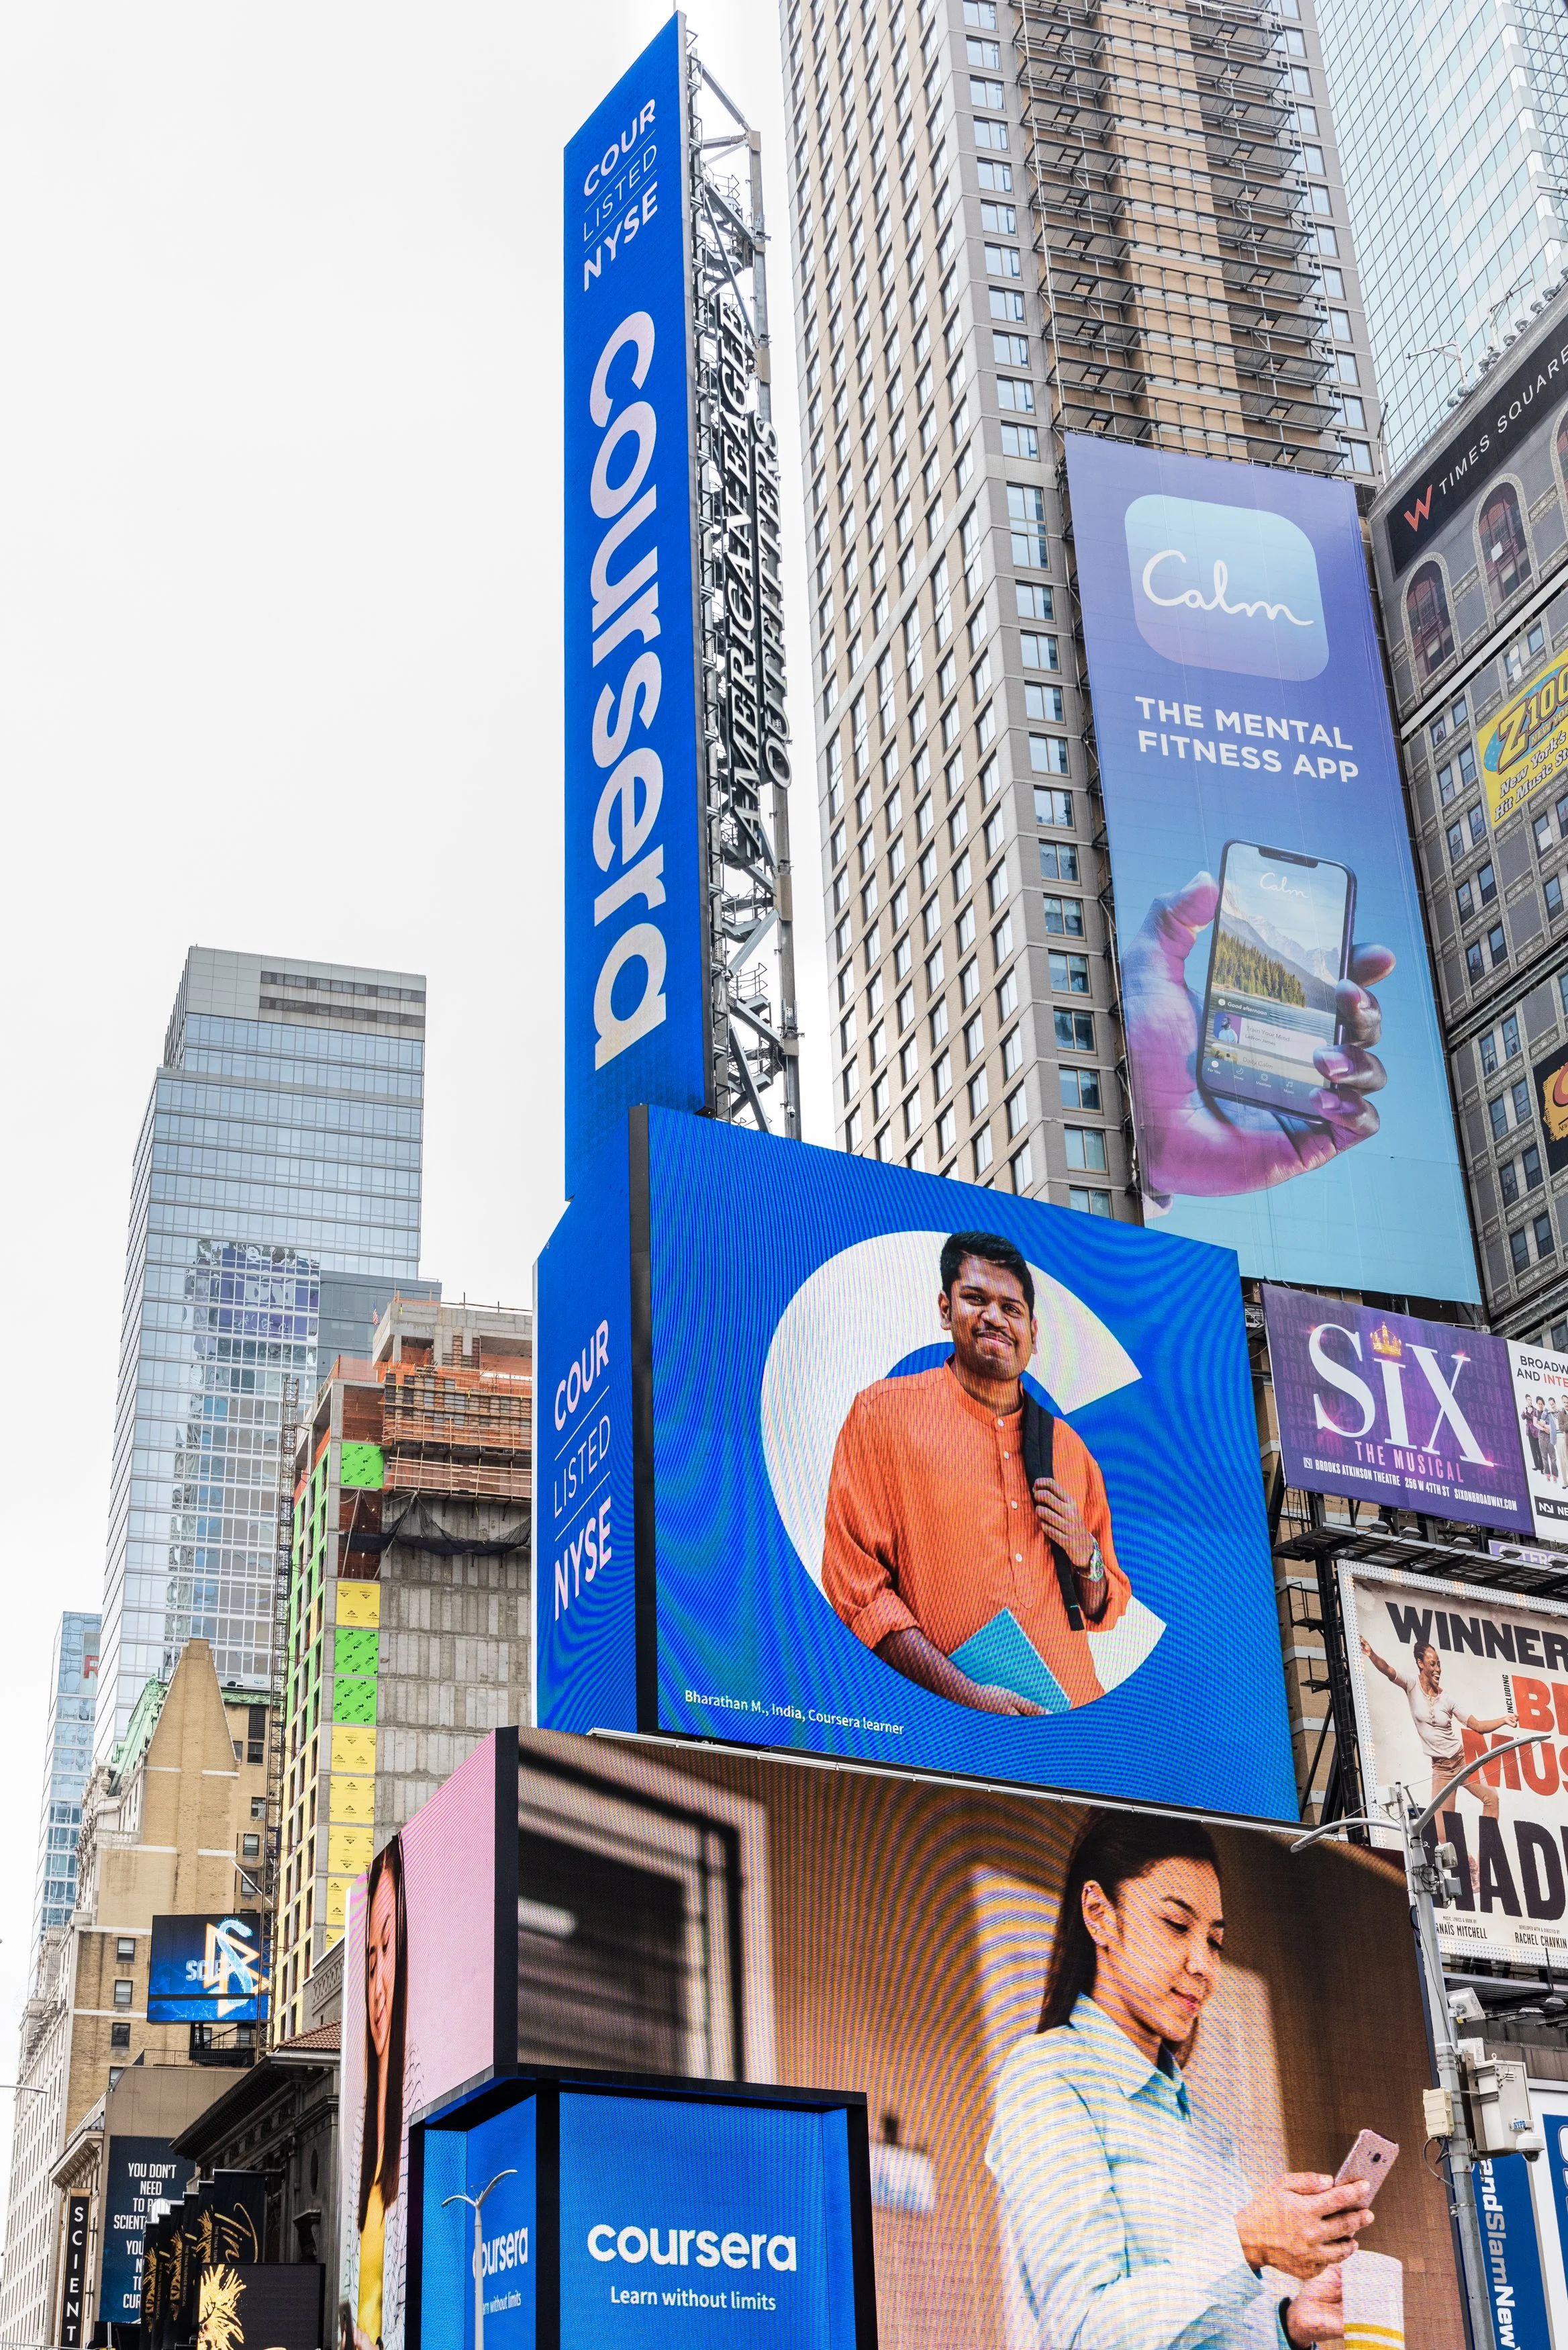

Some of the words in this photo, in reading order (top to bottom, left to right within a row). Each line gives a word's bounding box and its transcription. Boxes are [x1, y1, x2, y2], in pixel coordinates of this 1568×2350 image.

[584, 99, 656, 196] COUR
[583, 145, 657, 242] LISTED
[584, 181, 658, 291] NYSE
[718, 293, 750, 496] EAGLE
[1404, 484, 1432, 532] W
[1439, 434, 1489, 496] TIMES
[1497, 344, 1568, 434] SQUARE
[750, 411, 793, 790] OUTFITTERS
[1142, 550, 1314, 626] Calm
[590, 311, 667, 1071] coursera
[724, 473, 762, 855] AMERICAN
[1135, 696, 1204, 728] THE
[1215, 708, 1354, 751] MENTAL
[1138, 730, 1282, 773] FITNESS
[1293, 754, 1359, 783] APP
[1500, 765, 1529, 799] New
[1530, 730, 1566, 769] York's
[1495, 798, 1513, 822] Hit
[1515, 763, 1553, 803] Music
[1259, 872, 1310, 899] Calm
[1228, 1001, 1242, 1010] Good
[1243, 1006, 1267, 1016] afternoon
[1246, 1025, 1261, 1033] Train
[1261, 1029, 1275, 1037] Your
[1275, 1033, 1290, 1041] Mind
[554, 1319, 609, 1431] COUR
[1308, 1323, 1494, 1467] SIX
[1517, 1368, 1540, 1381] AND
[554, 1415, 611, 1519] LISTED
[1315, 1460, 1340, 1474] BROOKS
[1342, 1464, 1373, 1480] ATKINSON
[1373, 1470, 1401, 1486] THEATRE
[1404, 1477, 1417, 1491] 256
[1418, 1480, 1424, 1491] W
[1426, 1482, 1441, 1495] 47TH
[1442, 1487, 1450, 1497] ST
[1454, 1488, 1518, 1511] SIXONBROADWAY.COM
[1355, 1441, 1386, 1466] THE
[1393, 1448, 1464, 1483] MUSICAL
[554, 1496, 611, 1621] NYSE
[1385, 1601, 1568, 1673] WINNER
[685, 1689, 748, 1711] Bharathan
[751, 1699, 769, 1717] M.,
[772, 1703, 805, 1722] India,
[808, 1709, 860, 1729] Coursera
[863, 1717, 904, 1735] learner
[1502, 1675, 1514, 1713] INCLUDING
[1418, 1806, 1568, 1920] HAD
[1457, 1925, 1487, 1939] MITCHELL
[1514, 1932, 1538, 1945] RACHEL
[1540, 1935, 1567, 1948] CHAVKIN
[1514, 2120, 1526, 2130] NYPD
[128, 2163, 146, 2177] YOU
[149, 2164, 177, 2179] DON'T
[140, 2180, 162, 2196] NEED
[133, 2198, 144, 2212] TO
[472, 2226, 528, 2280] oursera
[587, 2224, 797, 2271] coursera
[490, 2294, 507, 2314] without
[507, 2289, 522, 2308] limits
[611, 2284, 658, 2307] Learn
[661, 2287, 728, 2309] without
[731, 2290, 777, 2311] limits
